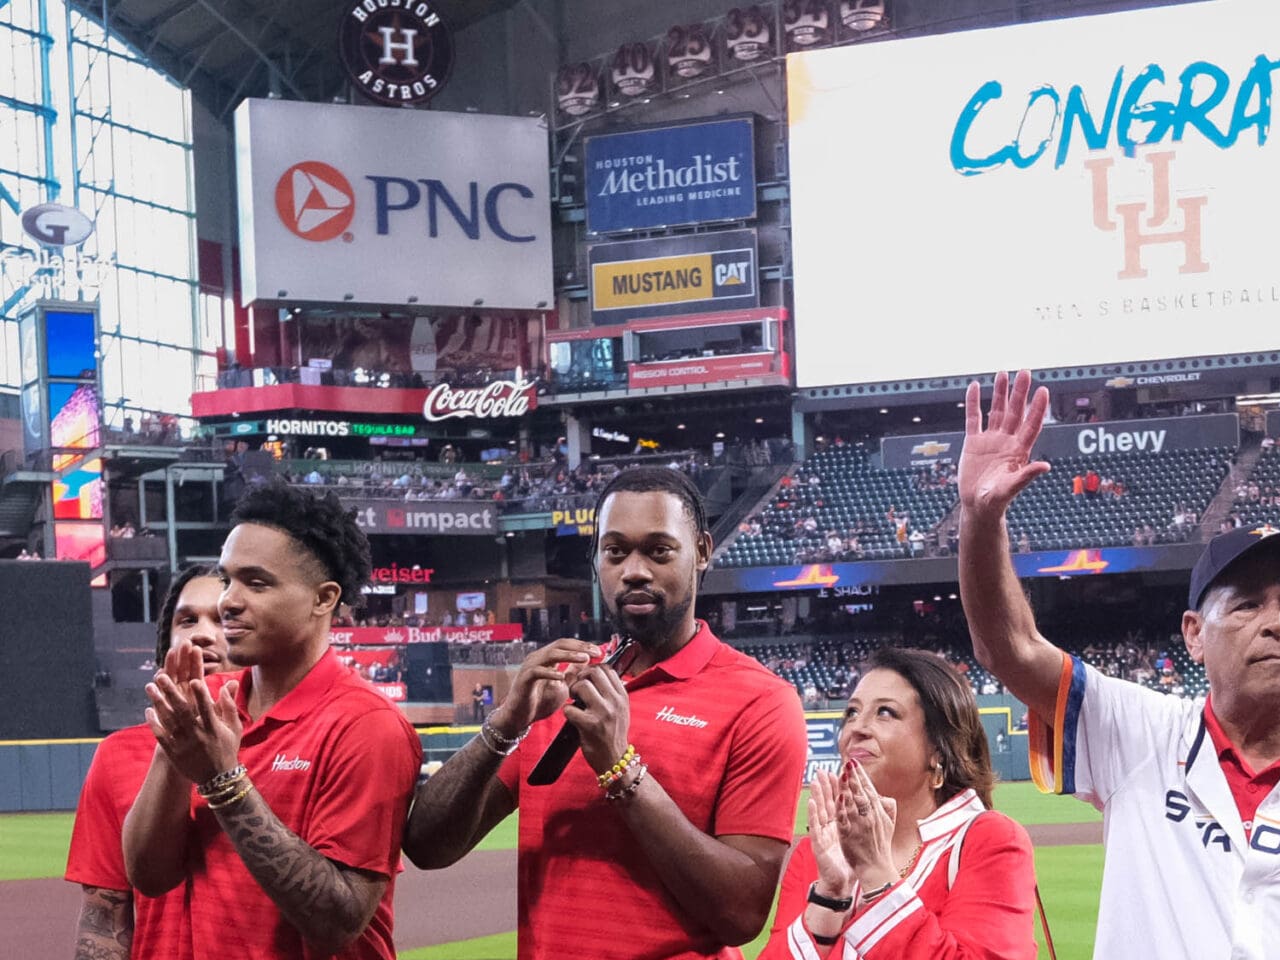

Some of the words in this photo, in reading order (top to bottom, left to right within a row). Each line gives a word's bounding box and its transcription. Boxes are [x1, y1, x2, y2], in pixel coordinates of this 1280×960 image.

[378, 26, 419, 65] H
[358, 69, 438, 99] ASTROS
[595, 155, 653, 169] HOUSTON
[598, 153, 742, 197] Methodist
[365, 175, 537, 243] PNC
[637, 193, 684, 207] LEADING
[688, 187, 742, 200] MEDICINE
[1084, 151, 1210, 280] UH
[612, 267, 702, 295] MUSTANG
[715, 261, 750, 286] CAT
[1137, 372, 1201, 385] CHEVROLET
[267, 420, 348, 436] HORNITOS
[353, 424, 393, 435] TEQUILA
[393, 424, 416, 435] BAR
[1078, 428, 1167, 454] Chevy
[406, 508, 492, 532] impact
[371, 562, 435, 583] eiser
[656, 705, 709, 729] Houston
[271, 753, 311, 772] Houston
